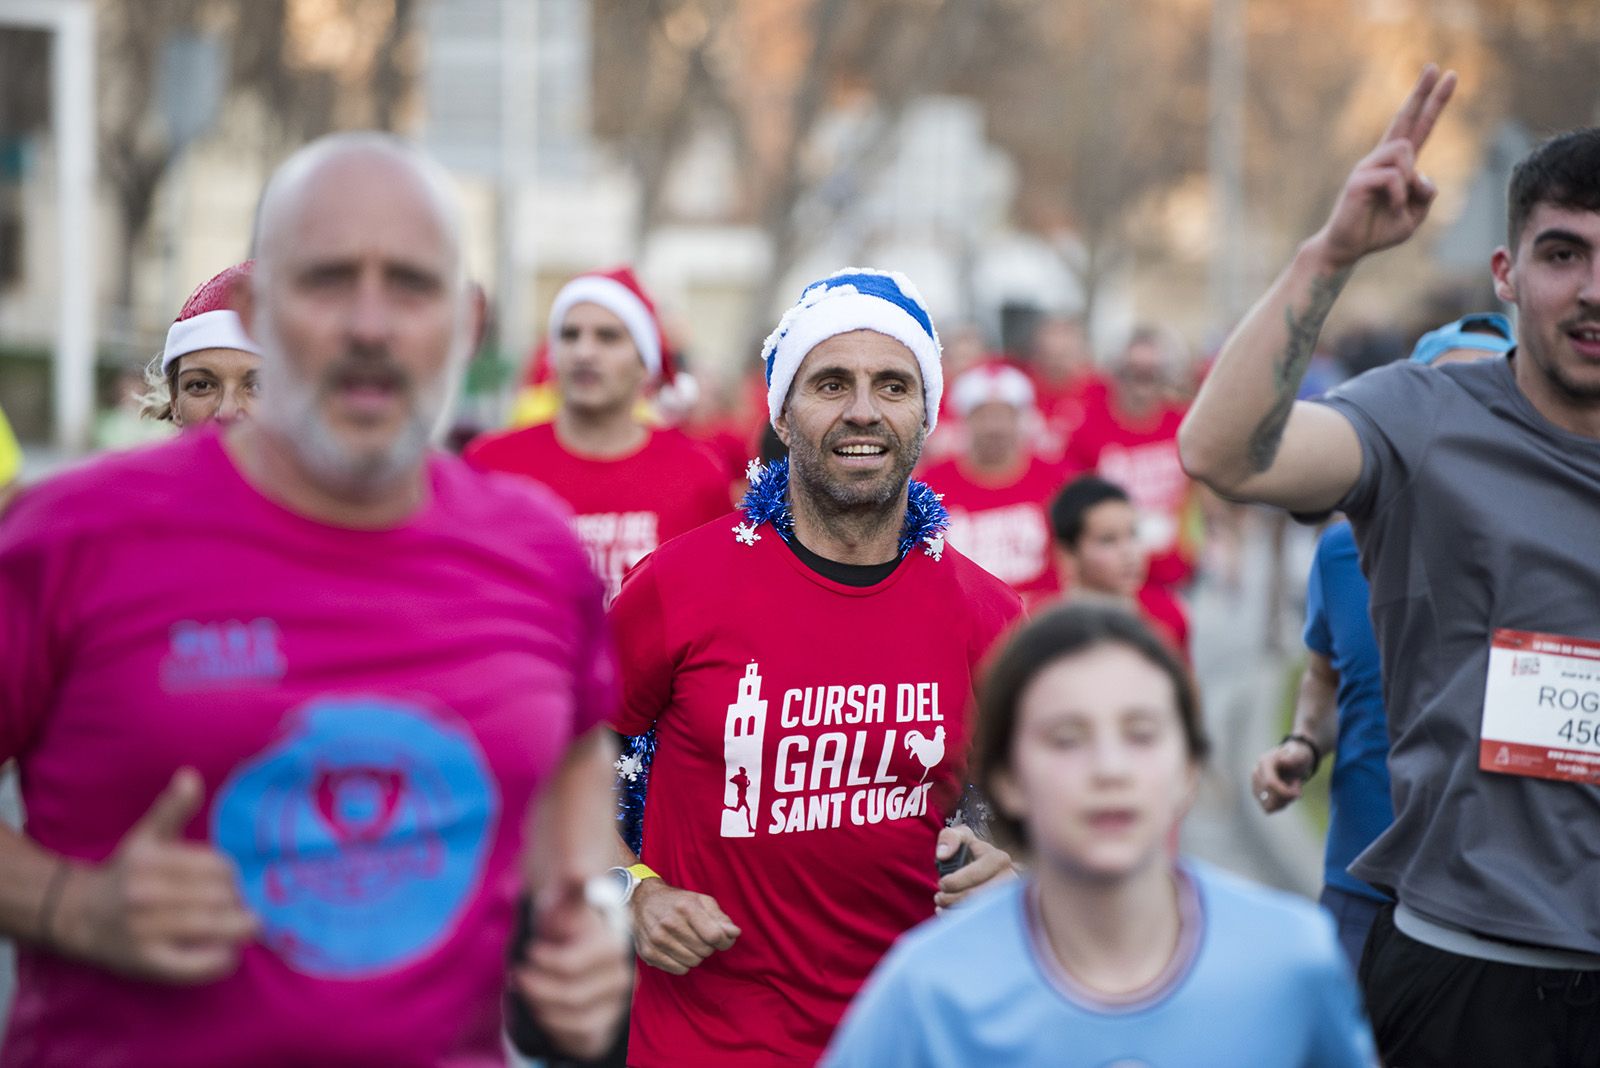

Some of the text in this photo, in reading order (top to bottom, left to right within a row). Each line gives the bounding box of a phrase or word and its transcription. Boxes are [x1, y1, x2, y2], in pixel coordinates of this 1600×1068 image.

[781, 682, 944, 728] CURSA DEL
[774, 729, 898, 793] GALL
[768, 782, 934, 834] SANT CUGAT
